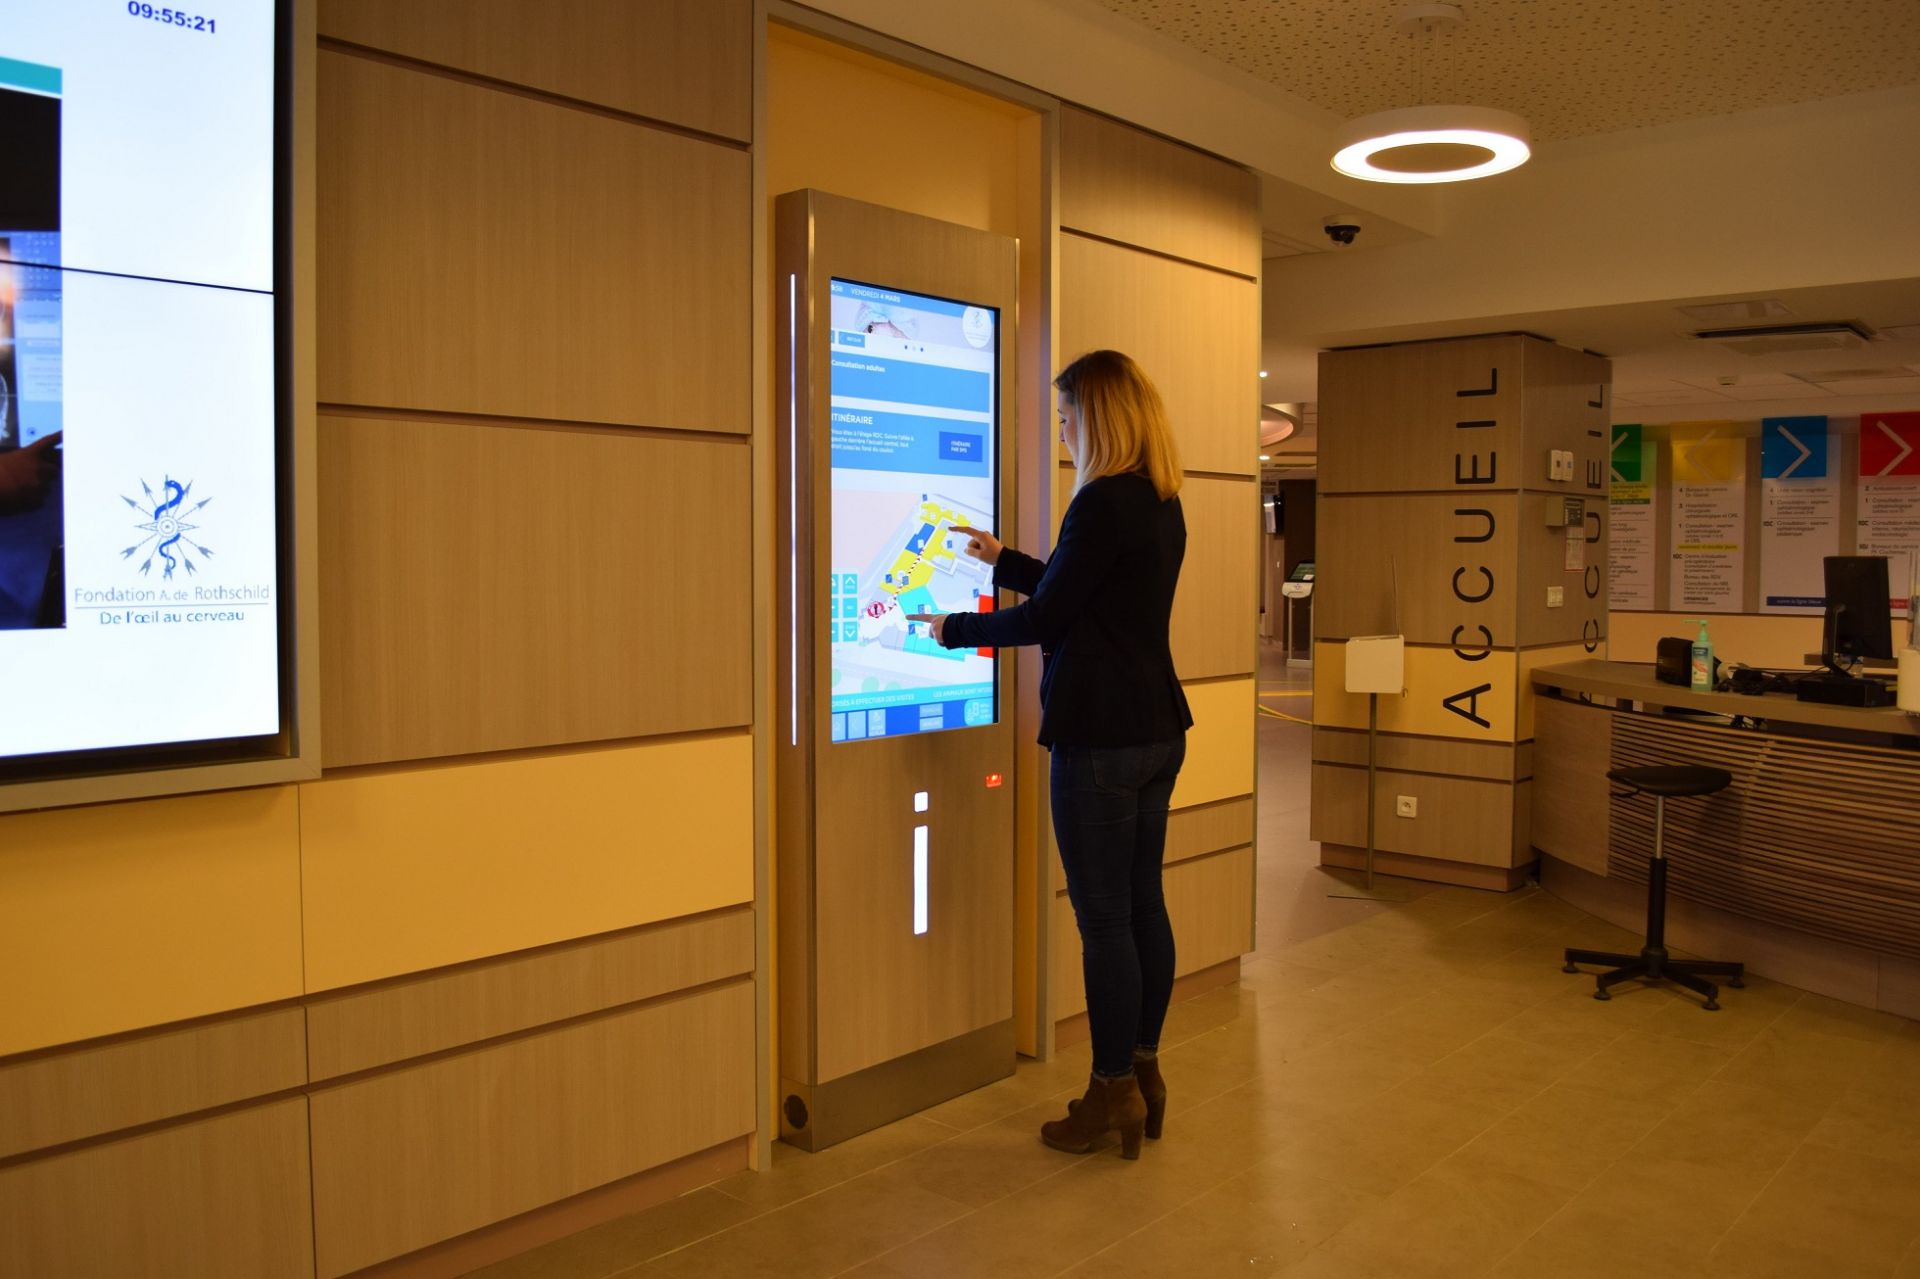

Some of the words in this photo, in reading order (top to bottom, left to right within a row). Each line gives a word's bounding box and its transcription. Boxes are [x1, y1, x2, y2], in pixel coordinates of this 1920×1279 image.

[128, 1, 216, 33] 09:55:21
[832, 413, 873, 425] ITINÉRAIRE
[1442, 367, 1498, 730] ACCUEIL
[75, 586, 156, 603] Fondation
[160, 590, 171, 602] A.
[173, 588, 189, 602] de
[194, 585, 270, 602] Rothschild
[100, 612, 122, 625] De
[125, 611, 160, 624] l'œil
[163, 613, 182, 624] au
[187, 611, 245, 624] cerveau
